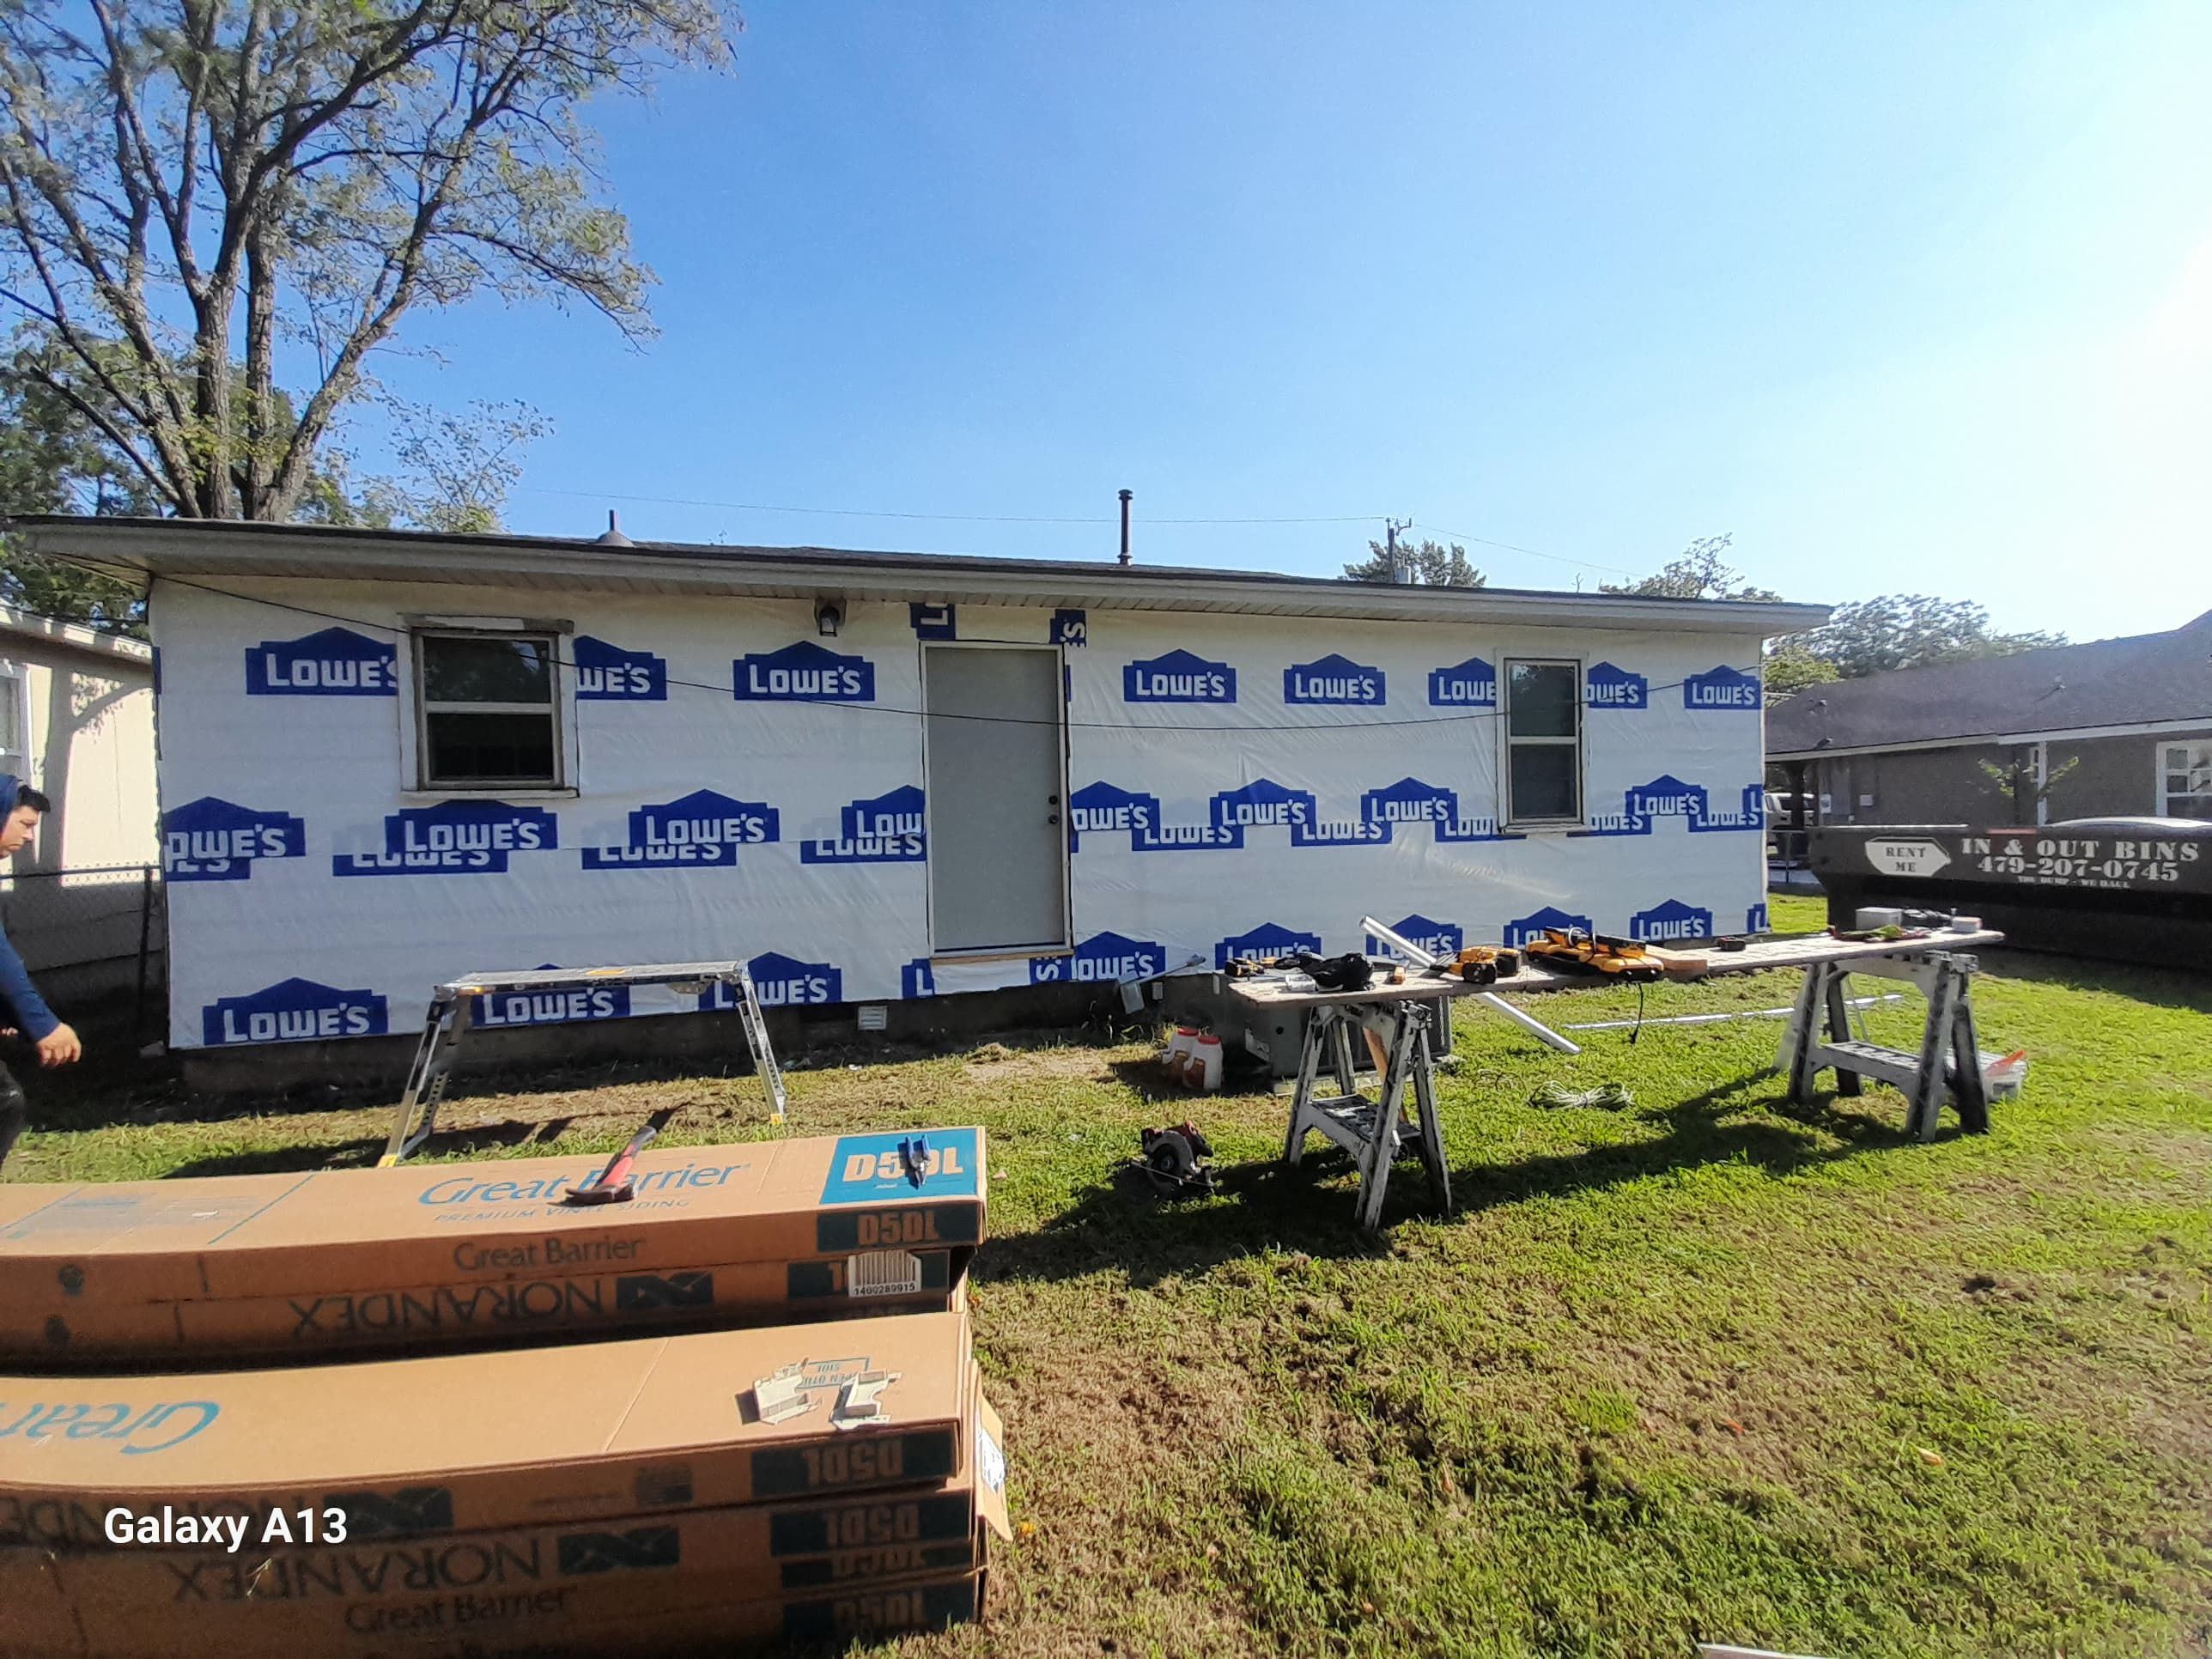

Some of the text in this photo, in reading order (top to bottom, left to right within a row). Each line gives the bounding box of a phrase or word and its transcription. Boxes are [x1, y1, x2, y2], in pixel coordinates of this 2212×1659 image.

[749, 664, 861, 694] LOWE'S
[1136, 670, 1225, 698] LOWE'S
[1295, 674, 1376, 700] LOWE'S
[1692, 684, 1756, 706] LOWE'S
[1221, 799, 1306, 825] LOWE'S
[1371, 796, 1449, 822] LOWE'S
[1634, 793, 1700, 816] LOWE'S
[164, 823, 287, 858] OWE'S
[404, 818, 541, 850] LOWE'S
[646, 812, 768, 844] LOWE'S
[1886, 846, 1926, 858] RENT
[1961, 838, 2199, 862] IN & OUT BINS
[1895, 861, 1917, 872] ME
[1977, 855, 2179, 882] 479-207-0745
[1638, 915, 1705, 939] LOWE'S
[714, 974, 829, 1008] LWE'S
[483, 987, 617, 1024] LOWE'S
[223, 1003, 371, 1044] LOWE'S
[418, 1174, 570, 1205] Great
[433, 1210, 536, 1224] PREMIUM
[617, 1198, 690, 1211] SIDING
[453, 1237, 642, 1273] Great Barrier
[289, 1279, 603, 1338] NORANDEX
[166, 1540, 543, 1600] NORANDEX
